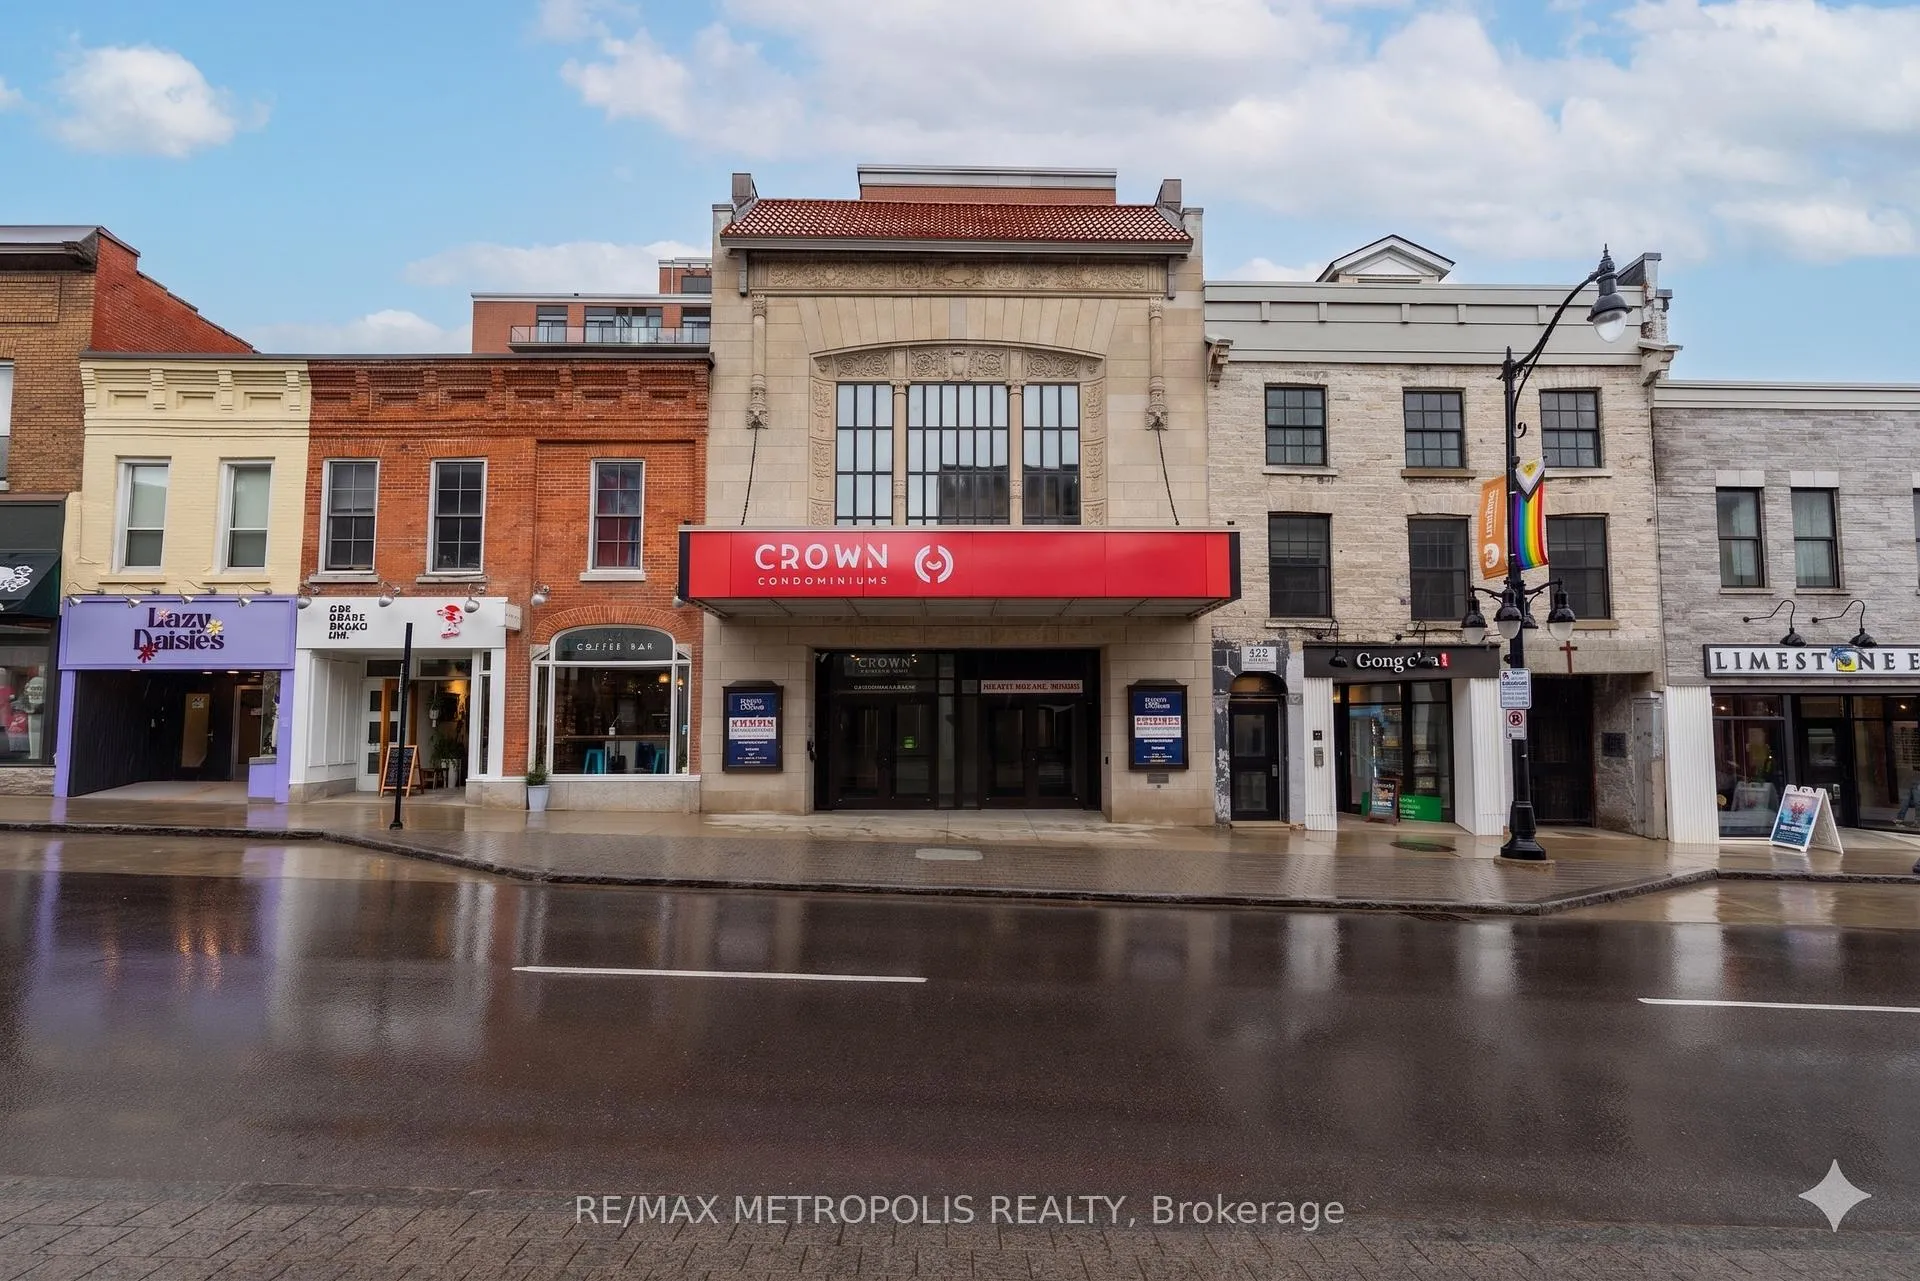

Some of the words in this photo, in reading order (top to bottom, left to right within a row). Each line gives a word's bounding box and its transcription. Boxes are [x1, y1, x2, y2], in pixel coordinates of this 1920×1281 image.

[755, 543, 888, 570] CROWN
[758, 576, 887, 586] CONDOMINIUMS
[147, 607, 212, 634] Lazy
[133, 628, 225, 651] Daisies
[576, 643, 621, 651] COFFEE
[858, 657, 911, 668] CROWN
[1356, 652, 1405, 673] Gong
